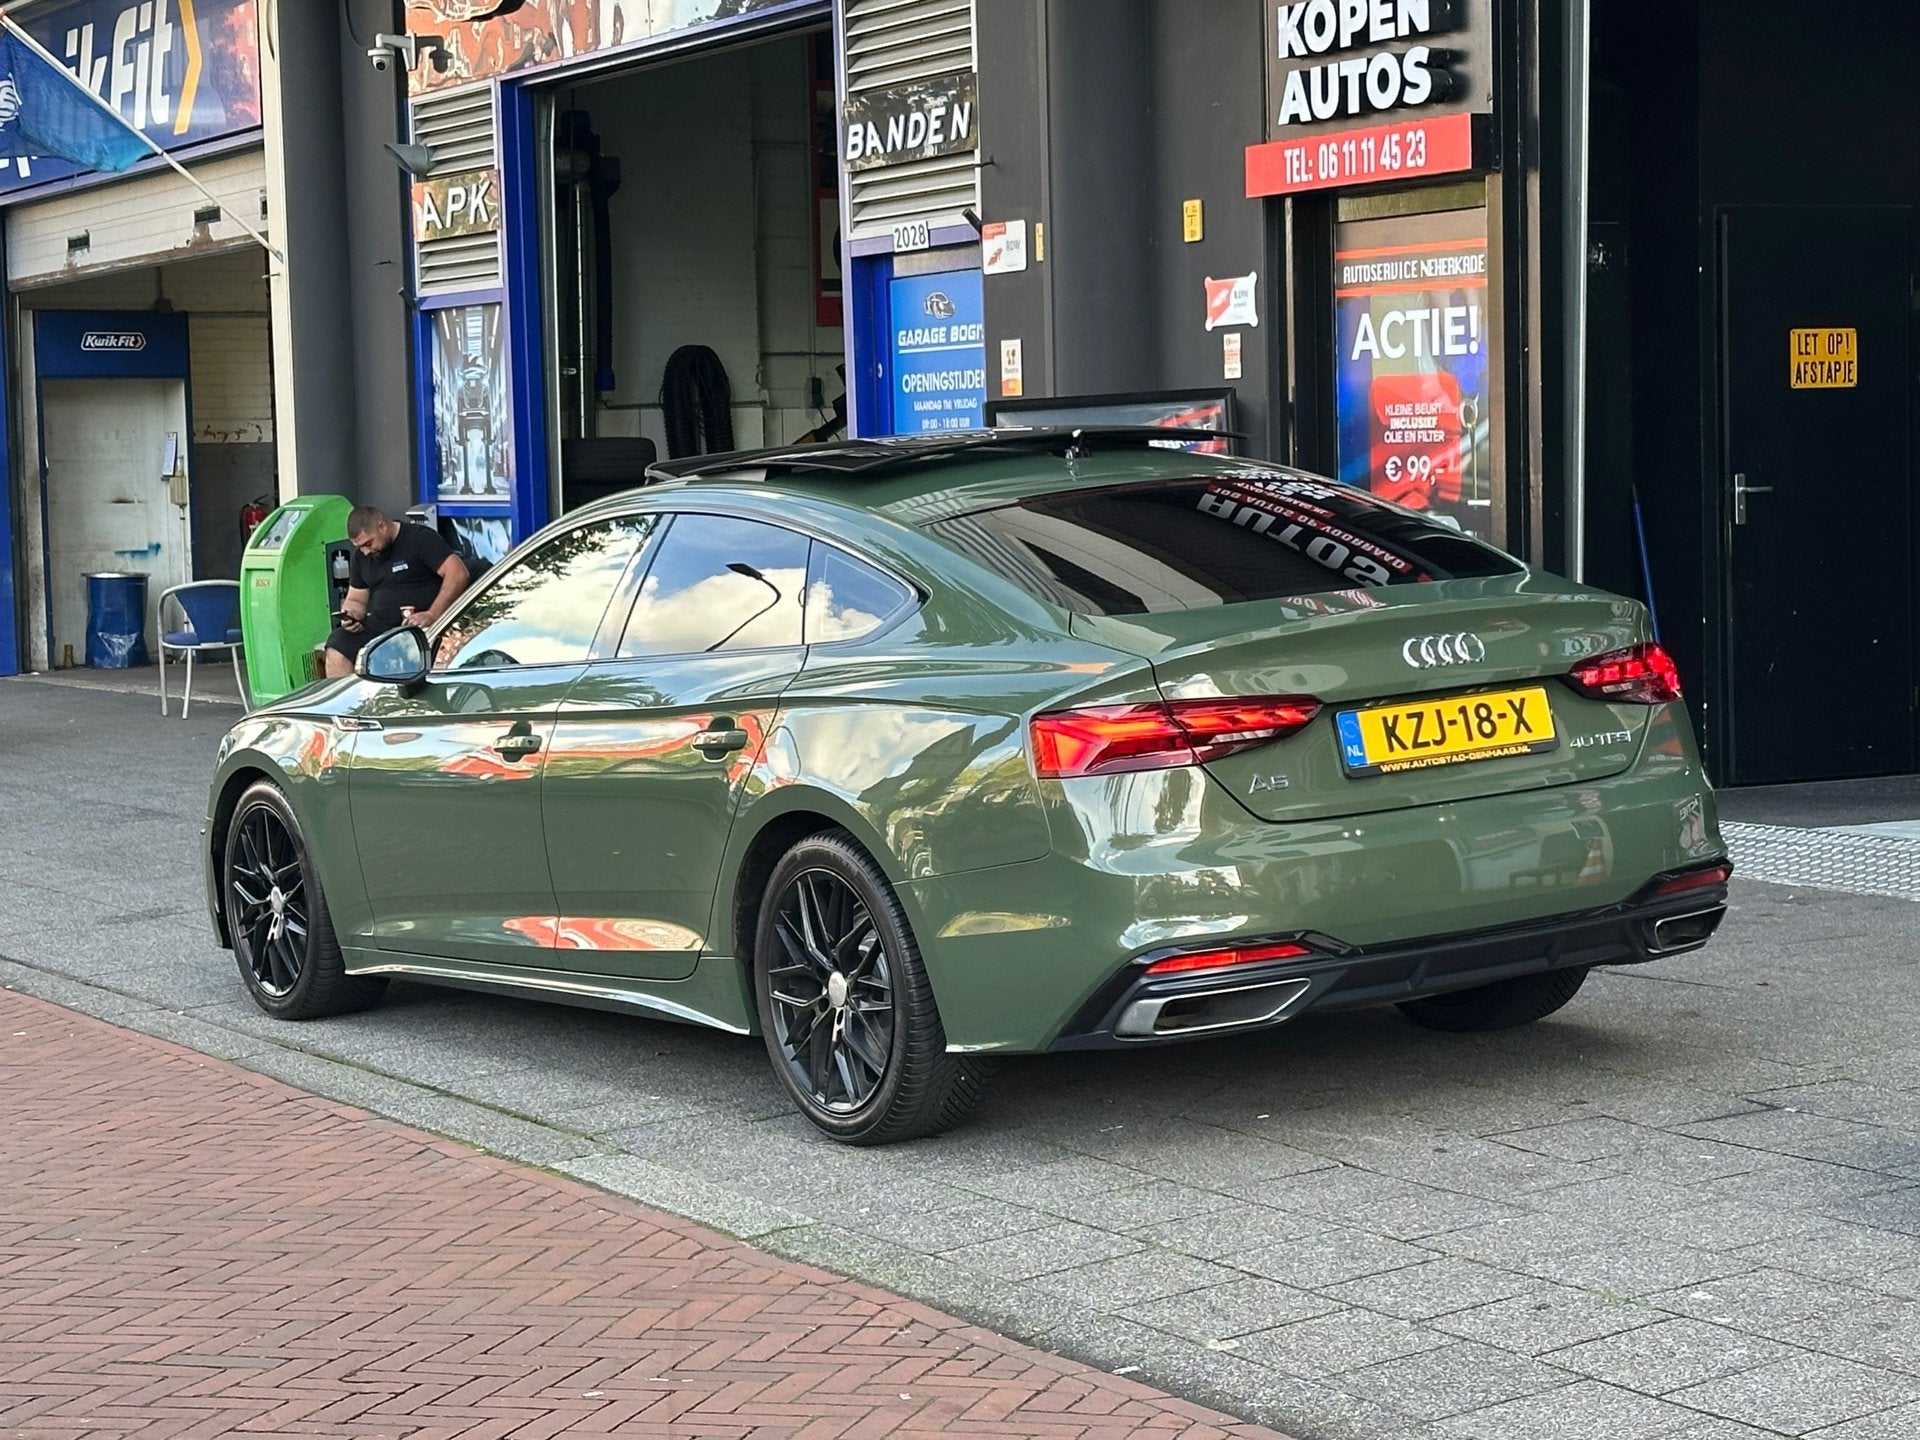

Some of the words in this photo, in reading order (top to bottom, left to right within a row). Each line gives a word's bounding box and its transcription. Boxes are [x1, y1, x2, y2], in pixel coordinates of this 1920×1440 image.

[1278, 0, 1430, 58] KOPEN
[1278, 46, 1432, 125] AUTOS
[846, 102, 970, 160] BANDEN
[1284, 147, 1313, 184] TEL:
[1318, 141, 1338, 180] 06
[1342, 139, 1356, 176] 11
[1361, 136, 1375, 174] 11
[1380, 133, 1401, 171] 45
[1406, 129, 1426, 168] 23
[421, 181, 491, 232] APK
[894, 225, 926, 249] 2028
[1343, 260, 1419, 285] AUTOSERVICE
[1420, 254, 1486, 278] NEHERKADE
[898, 326, 947, 347] GARAGE
[1351, 305, 1478, 361] ACTIE!
[1797, 333, 1818, 355] LET
[1827, 332, 1850, 355] OP!
[1795, 361, 1854, 384] AFSTAPJE
[1384, 403, 1414, 416] KLEINE
[1415, 402, 1443, 415] BEURT
[1384, 431, 1404, 443] OLIE
[1404, 430, 1416, 442] EN
[1417, 430, 1445, 443] FILTER
[1390, 416, 1438, 430] INCLUSIEF
[1385, 456, 1402, 482] €
[1407, 455, 1445, 486] 99,-
[1381, 697, 1533, 752] KZJ-18-X
[1347, 745, 1363, 757] NL
[1249, 774, 1289, 794] A5
